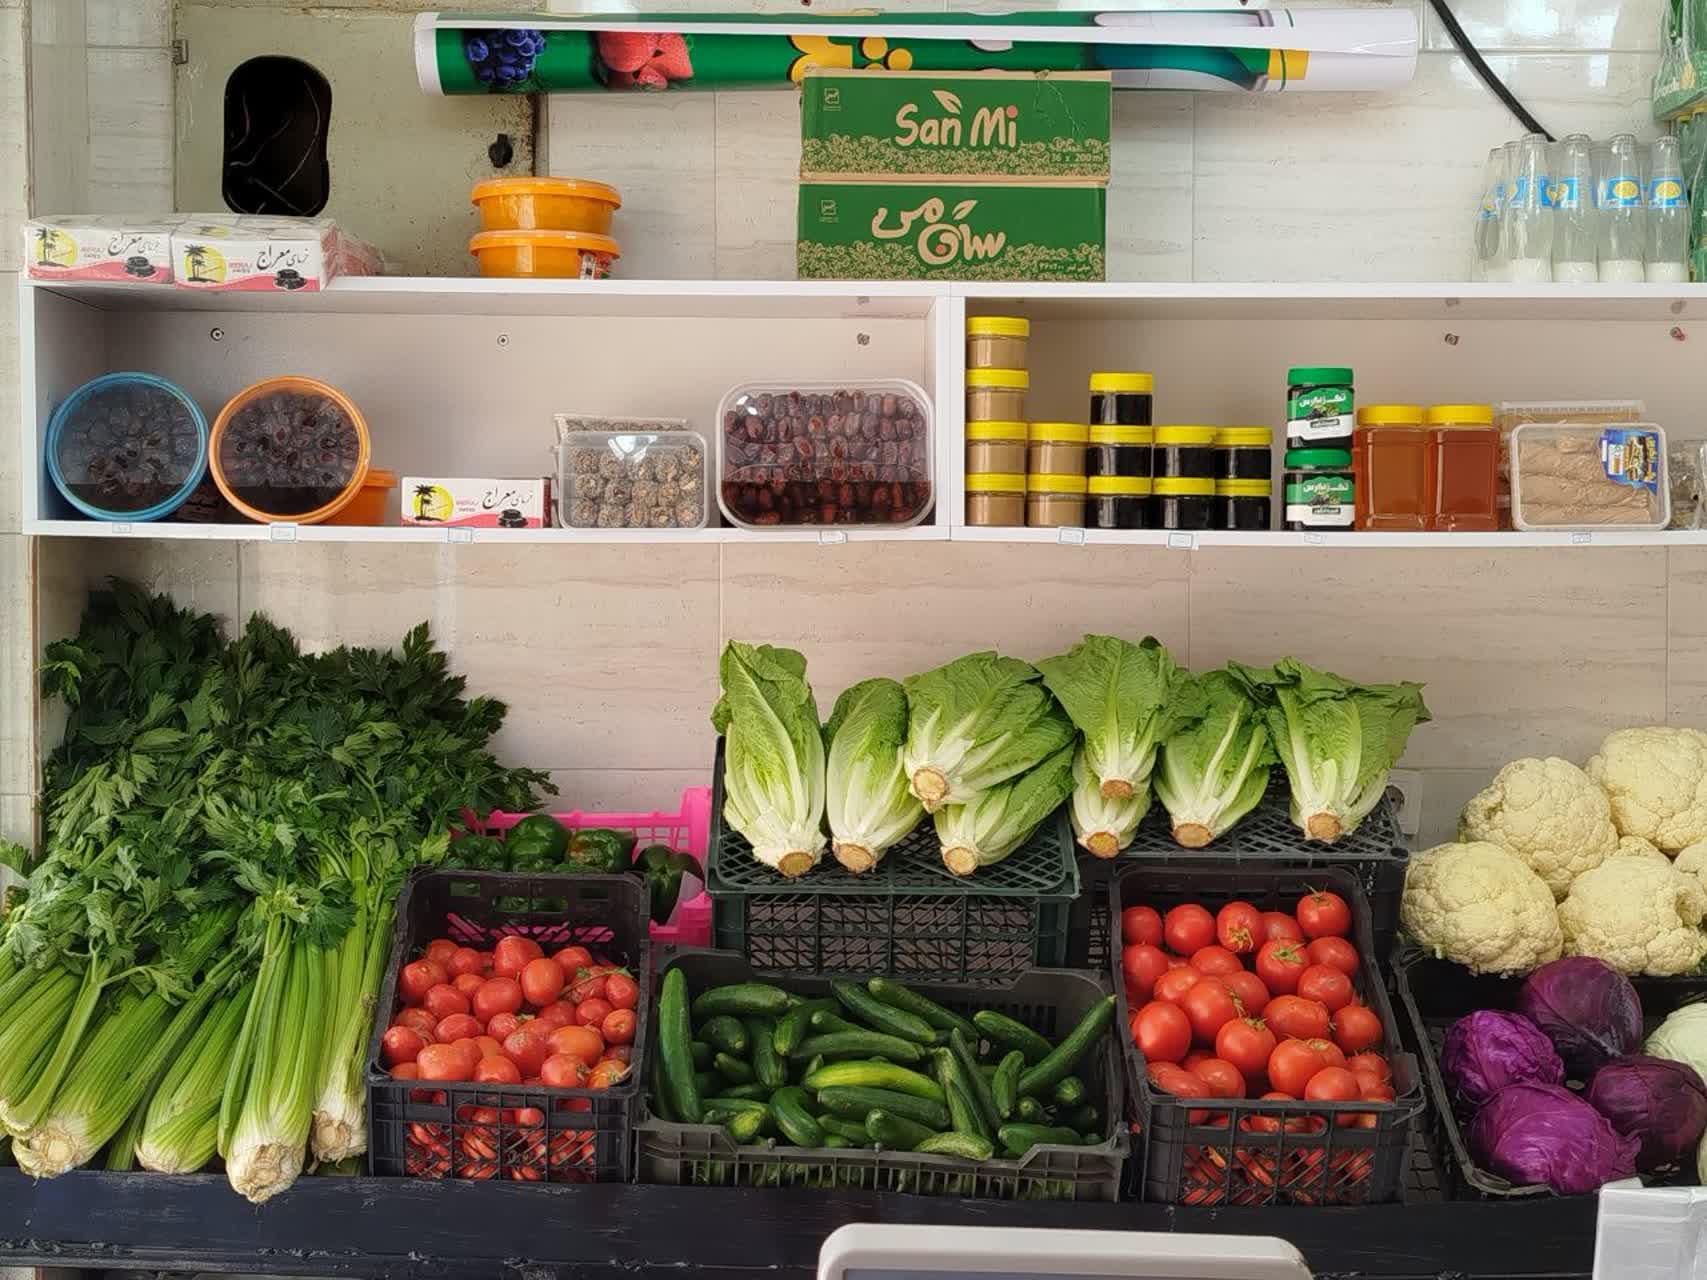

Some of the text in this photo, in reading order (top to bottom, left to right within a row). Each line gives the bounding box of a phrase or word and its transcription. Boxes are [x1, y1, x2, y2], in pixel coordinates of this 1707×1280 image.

[896, 103, 1018, 148] San Mi
[107, 232, 143, 256] معراج
[871, 197, 1006, 264] سان می
[256, 244, 290, 271] معراج
[482, 487, 516, 510] معراج
